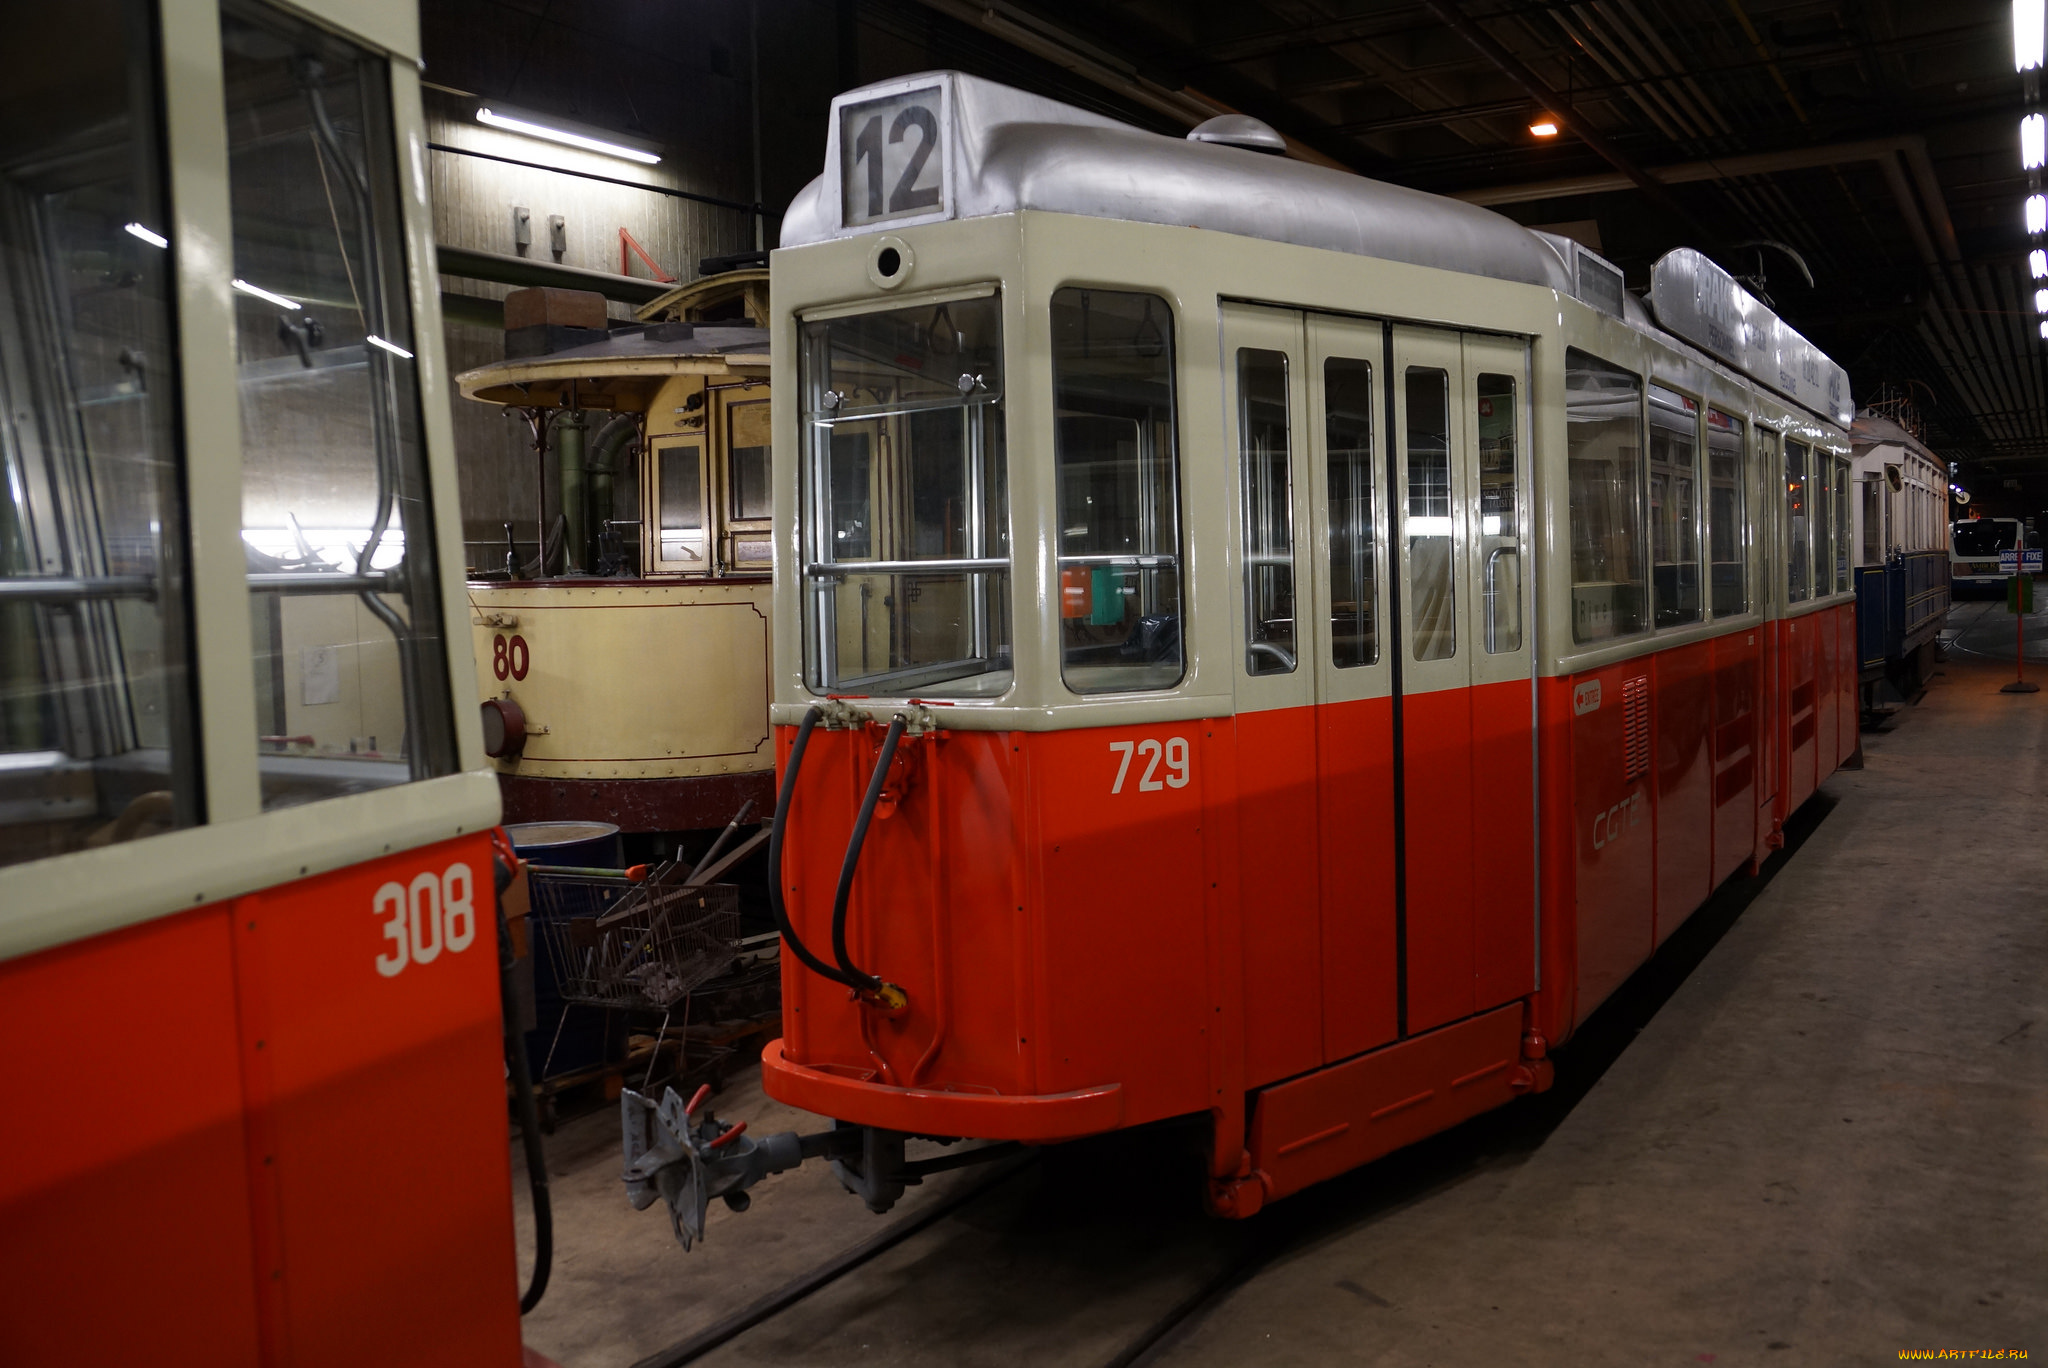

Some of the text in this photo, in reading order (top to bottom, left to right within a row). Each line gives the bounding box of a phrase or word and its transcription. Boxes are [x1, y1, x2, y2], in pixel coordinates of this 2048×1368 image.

[856, 105, 938, 217] 12
[2026, 551, 2042, 561] FIXE
[493, 633, 529, 681] 80
[1109, 736, 1190, 794] 729
[1593, 791, 1640, 850] CGTE
[372, 862, 475, 978] 308
